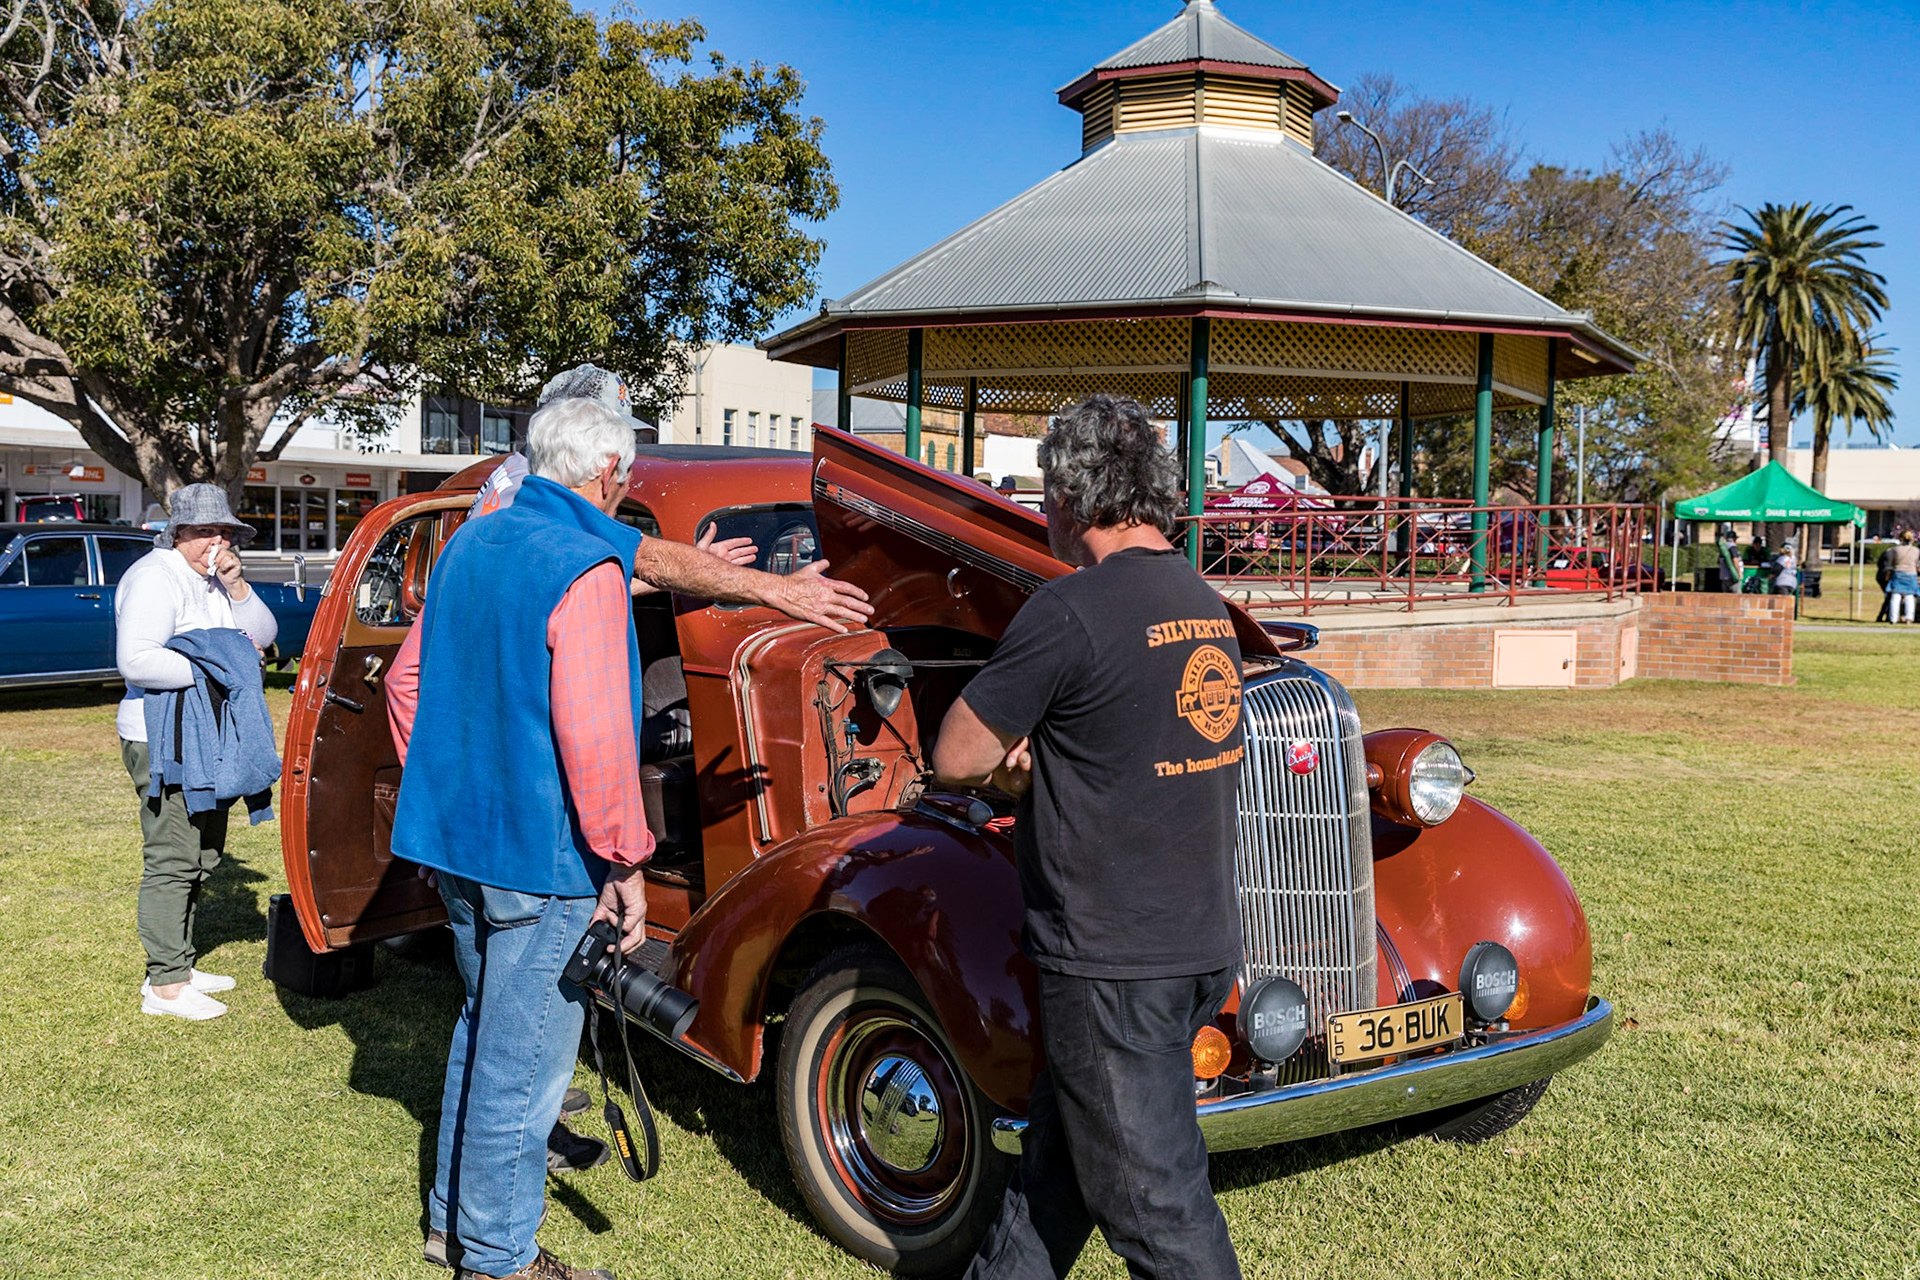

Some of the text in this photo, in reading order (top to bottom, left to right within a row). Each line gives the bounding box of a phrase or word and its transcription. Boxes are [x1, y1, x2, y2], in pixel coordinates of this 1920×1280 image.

[1765, 508, 1787, 517] SHARE
[1788, 509, 1800, 517] THE
[1802, 508, 1831, 517] PASSION
[1146, 618, 1236, 648] SILVERTON
[1189, 652, 1234, 686] SILVERTON
[1204, 716, 1233, 734] HOTEL
[1154, 761, 1184, 777] The
[1186, 758, 1217, 774] home
[1476, 969, 1516, 990] BOSCH
[1254, 1004, 1306, 1030] BOSCH
[615, 1130, 630, 1158] Nikon
